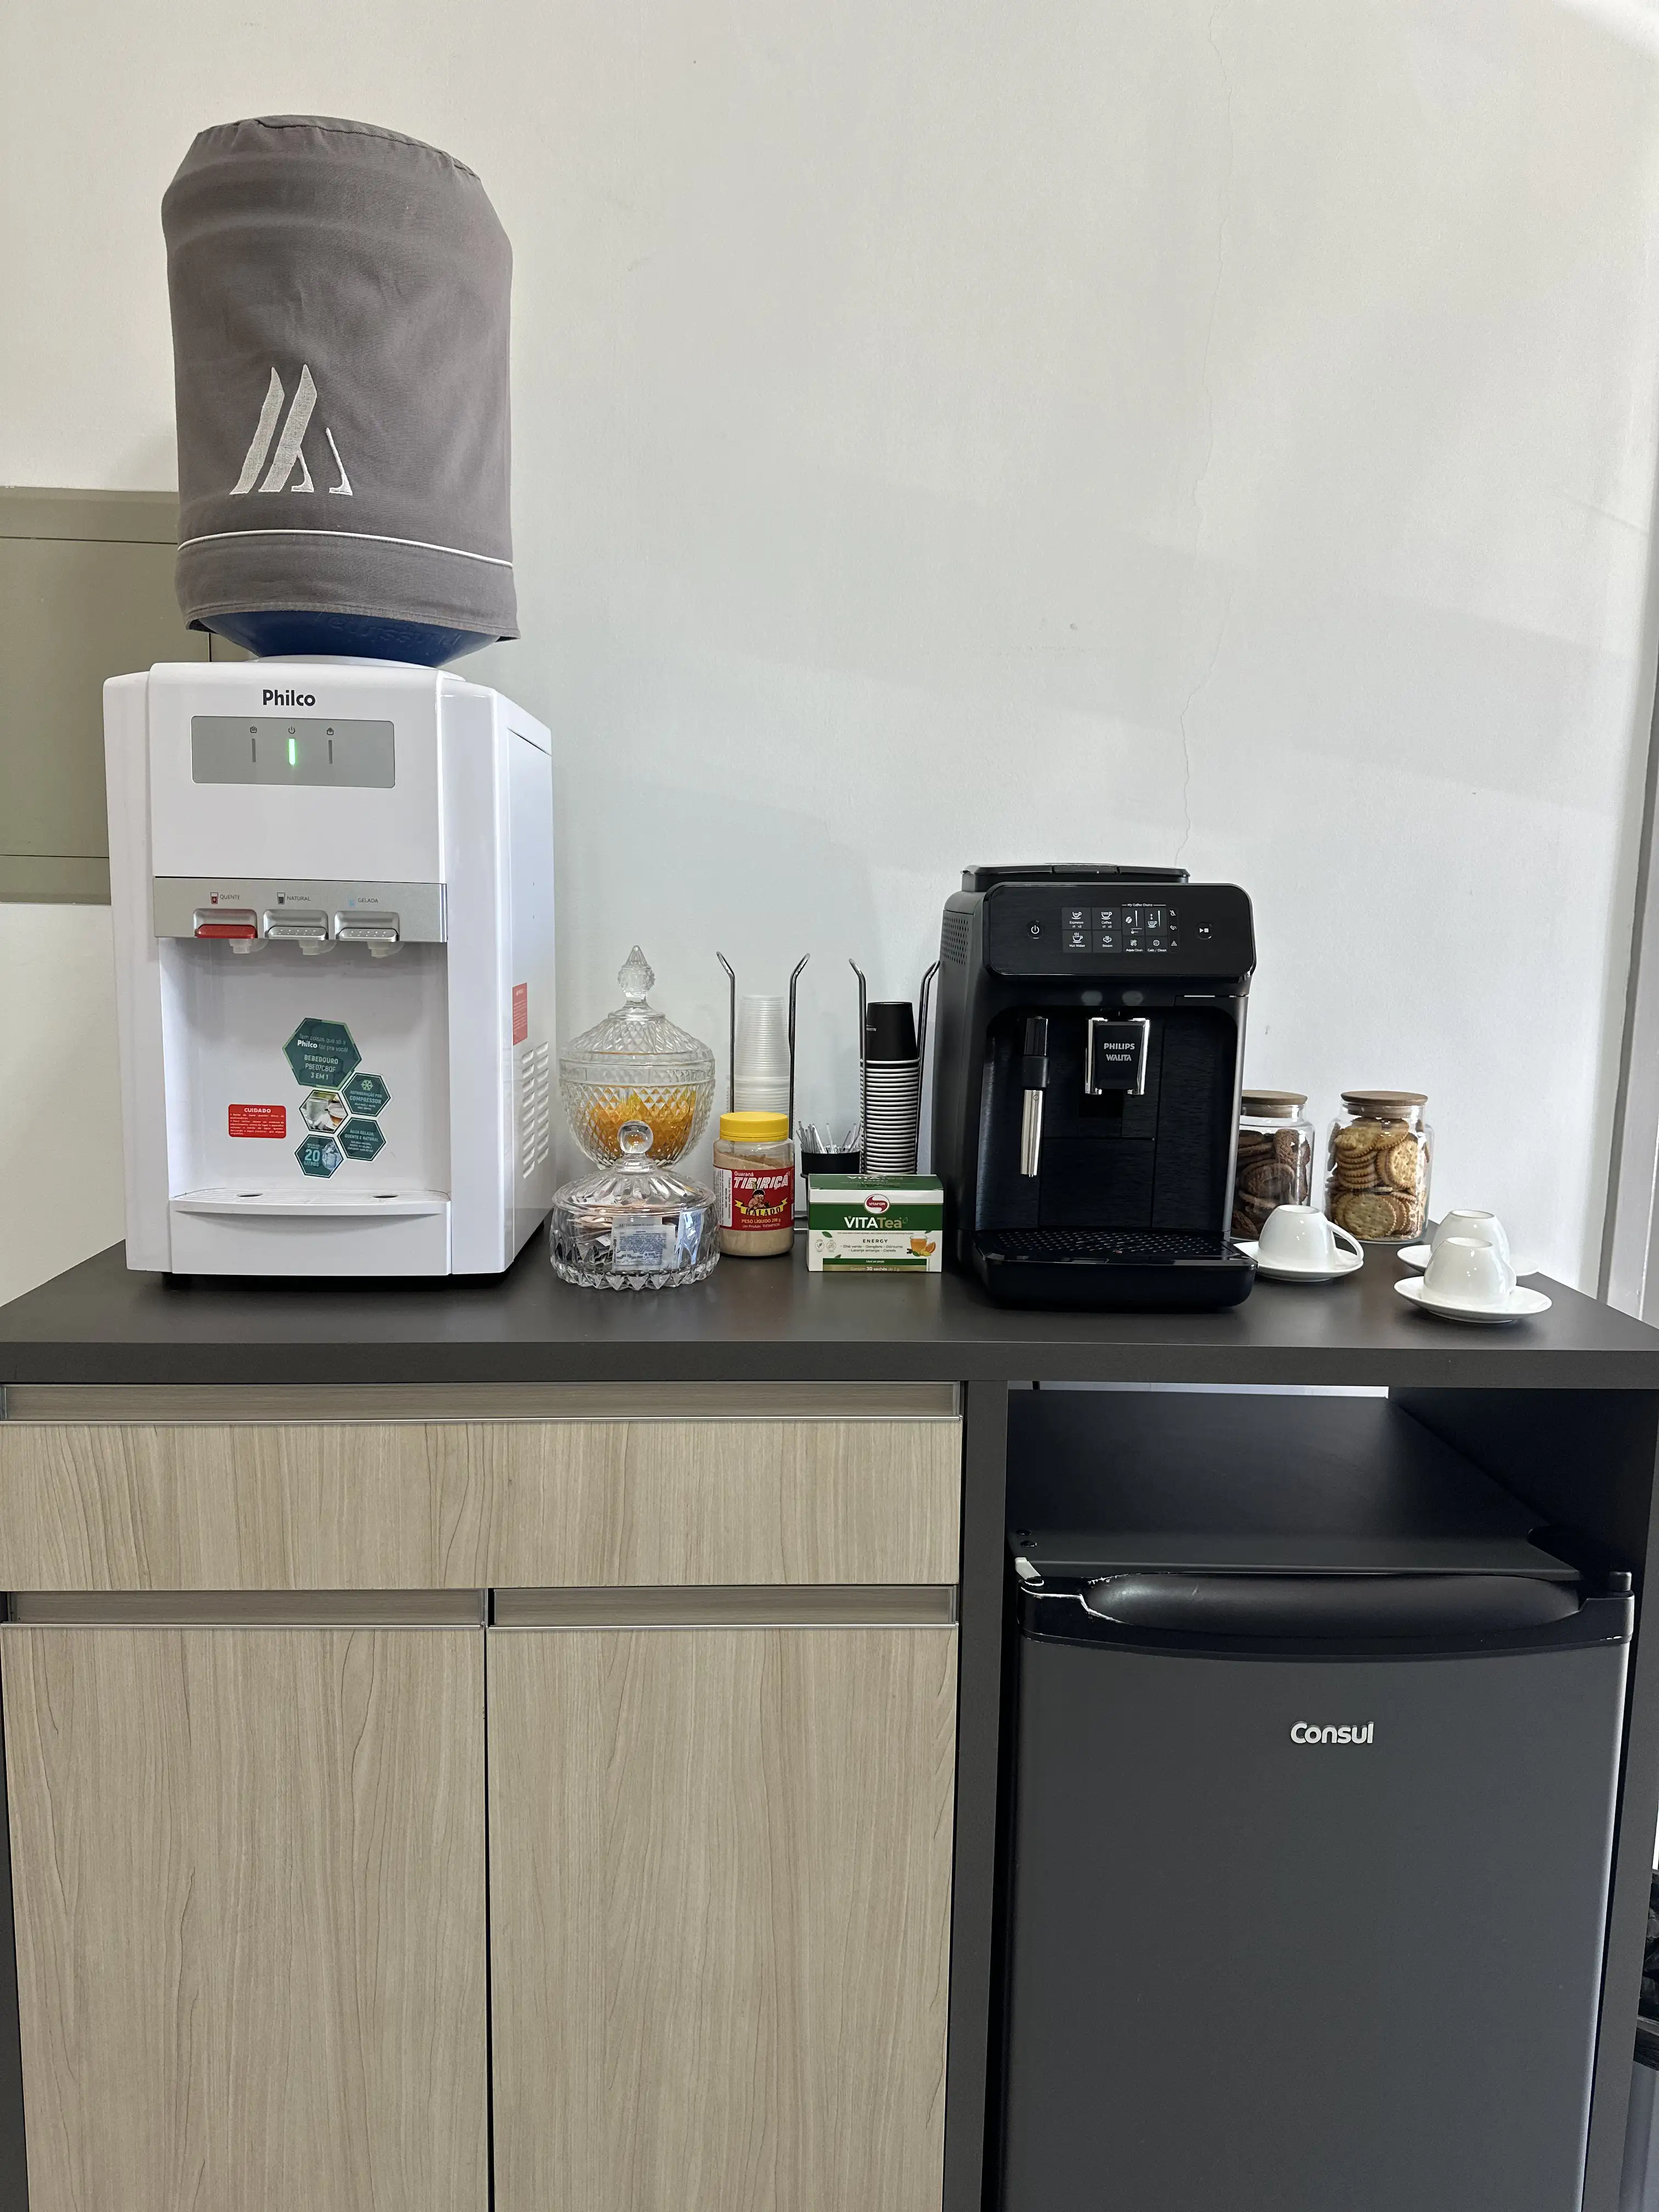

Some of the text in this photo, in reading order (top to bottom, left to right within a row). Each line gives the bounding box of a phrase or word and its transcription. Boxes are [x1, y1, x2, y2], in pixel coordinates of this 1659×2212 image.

[263, 690, 315, 706] Philco
[297, 1040, 318, 1048] Philco
[304, 1054, 338, 1064] BEBEDOURO
[349, 1095, 382, 1104] COMPRESSOR
[304, 1148, 320, 1162] 20
[733, 1172, 789, 1190] TIBIRIÇÁ
[746, 1207, 781, 1216] RALADO
[844, 1216, 902, 1228] VITATea
[1290, 1720, 1374, 1744] Consul
